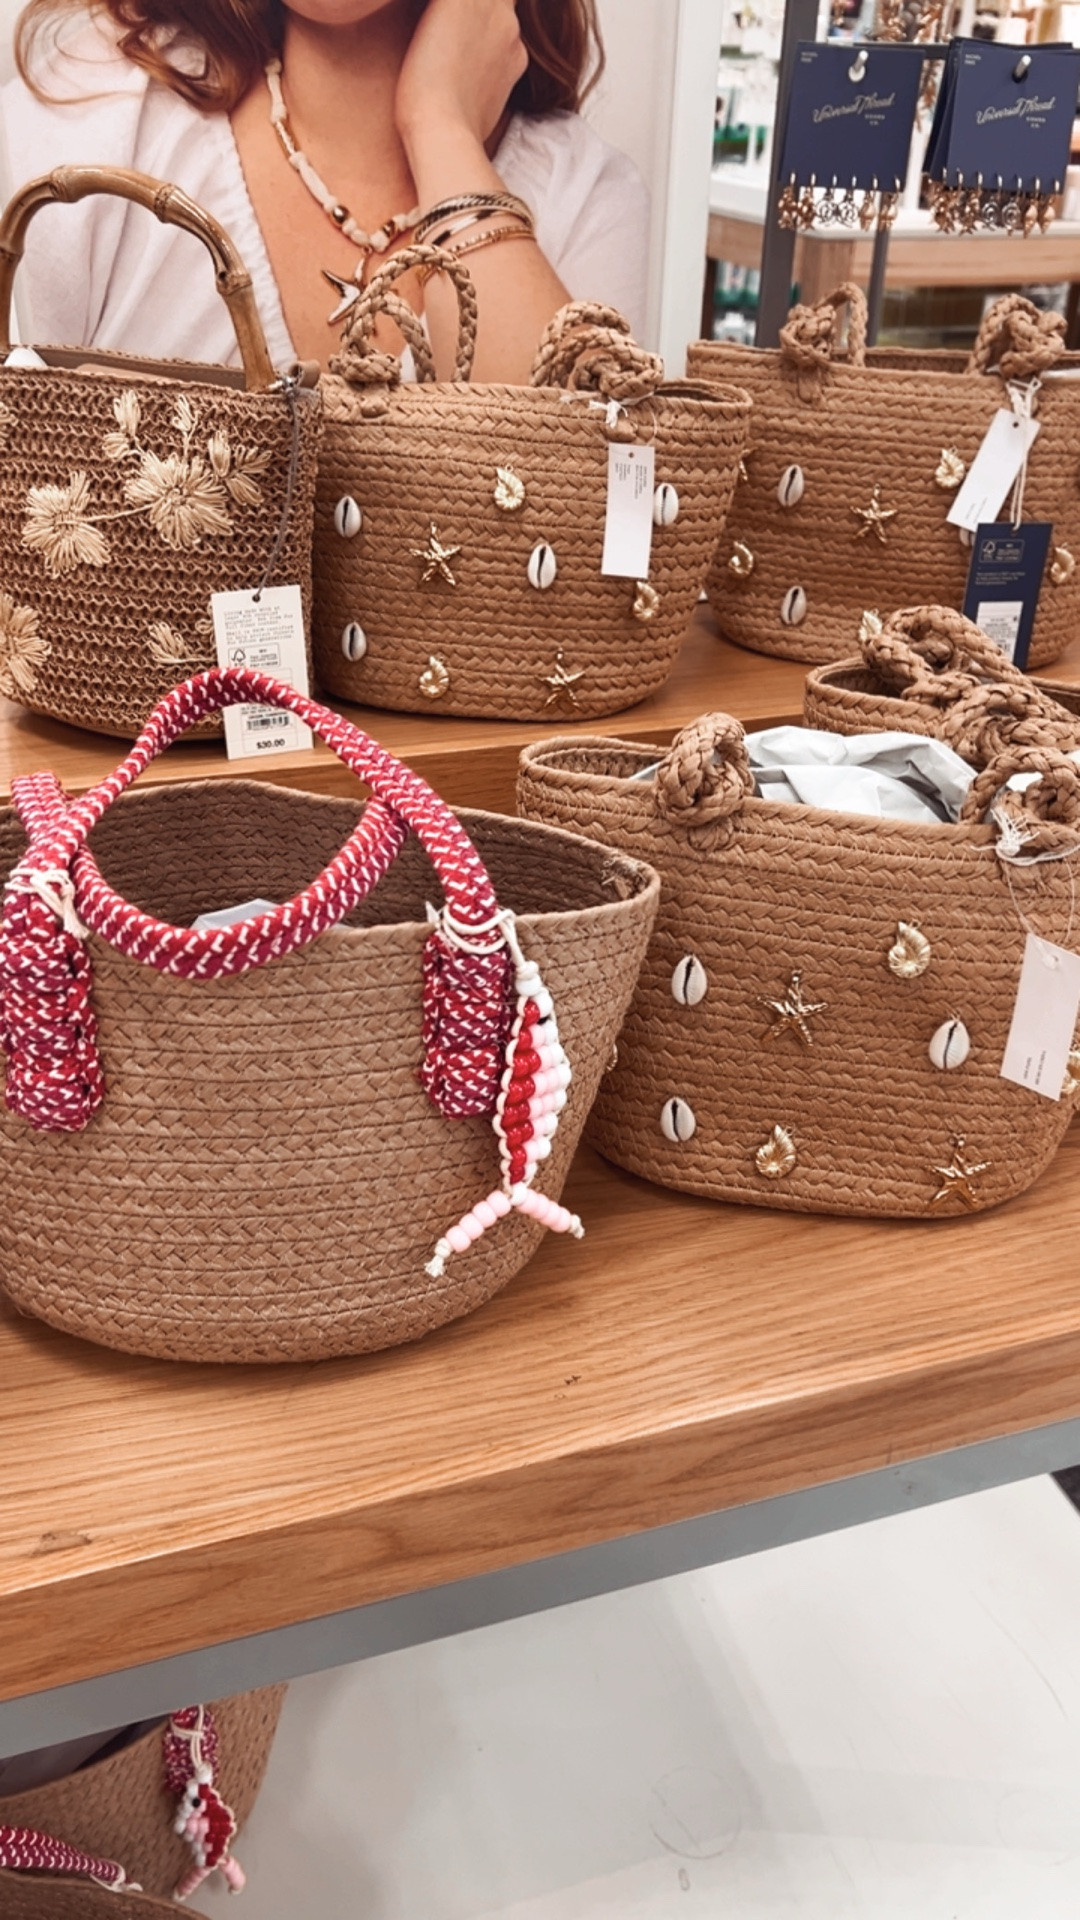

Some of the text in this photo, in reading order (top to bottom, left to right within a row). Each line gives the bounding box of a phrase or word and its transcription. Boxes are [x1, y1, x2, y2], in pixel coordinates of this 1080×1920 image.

[813, 92, 895, 123] Universal Thread
[976, 96, 1056, 124] Universal Thread
[256, 738, 285, 749] $30.00
